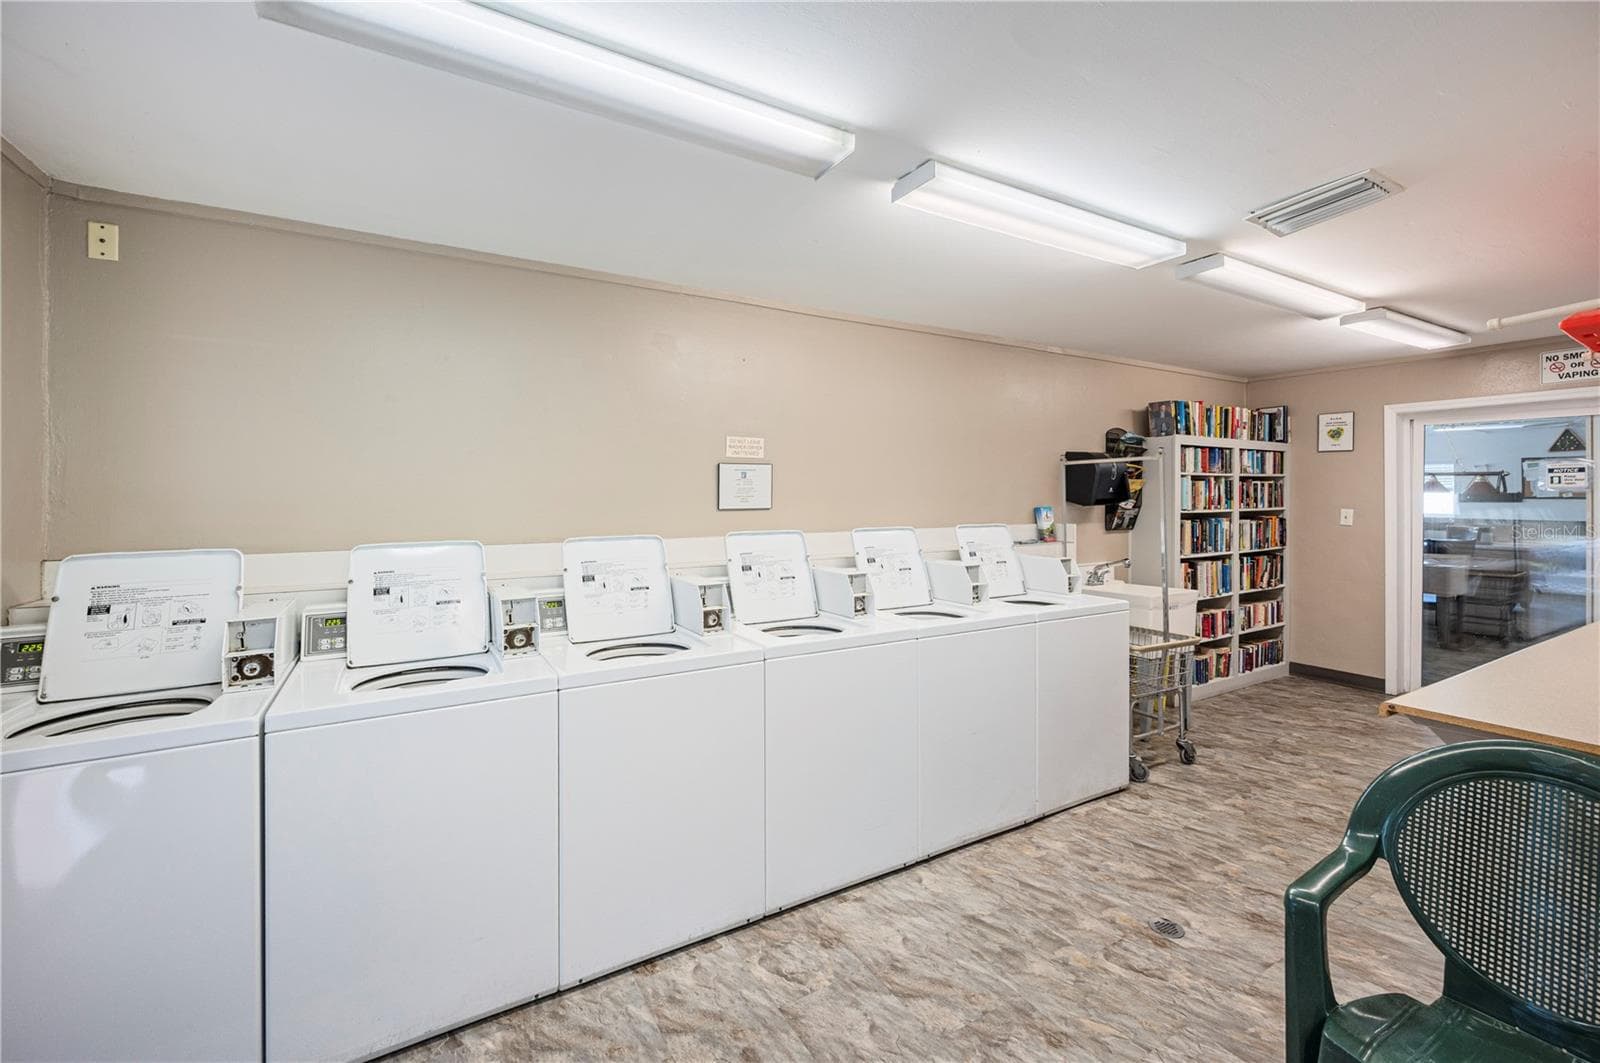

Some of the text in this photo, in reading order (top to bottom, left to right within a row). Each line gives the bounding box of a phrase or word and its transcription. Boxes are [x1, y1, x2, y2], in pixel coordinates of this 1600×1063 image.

[1570, 361, 1585, 369] OR
[1558, 369, 1599, 380] VAPING
[21, 643, 43, 653] 225
